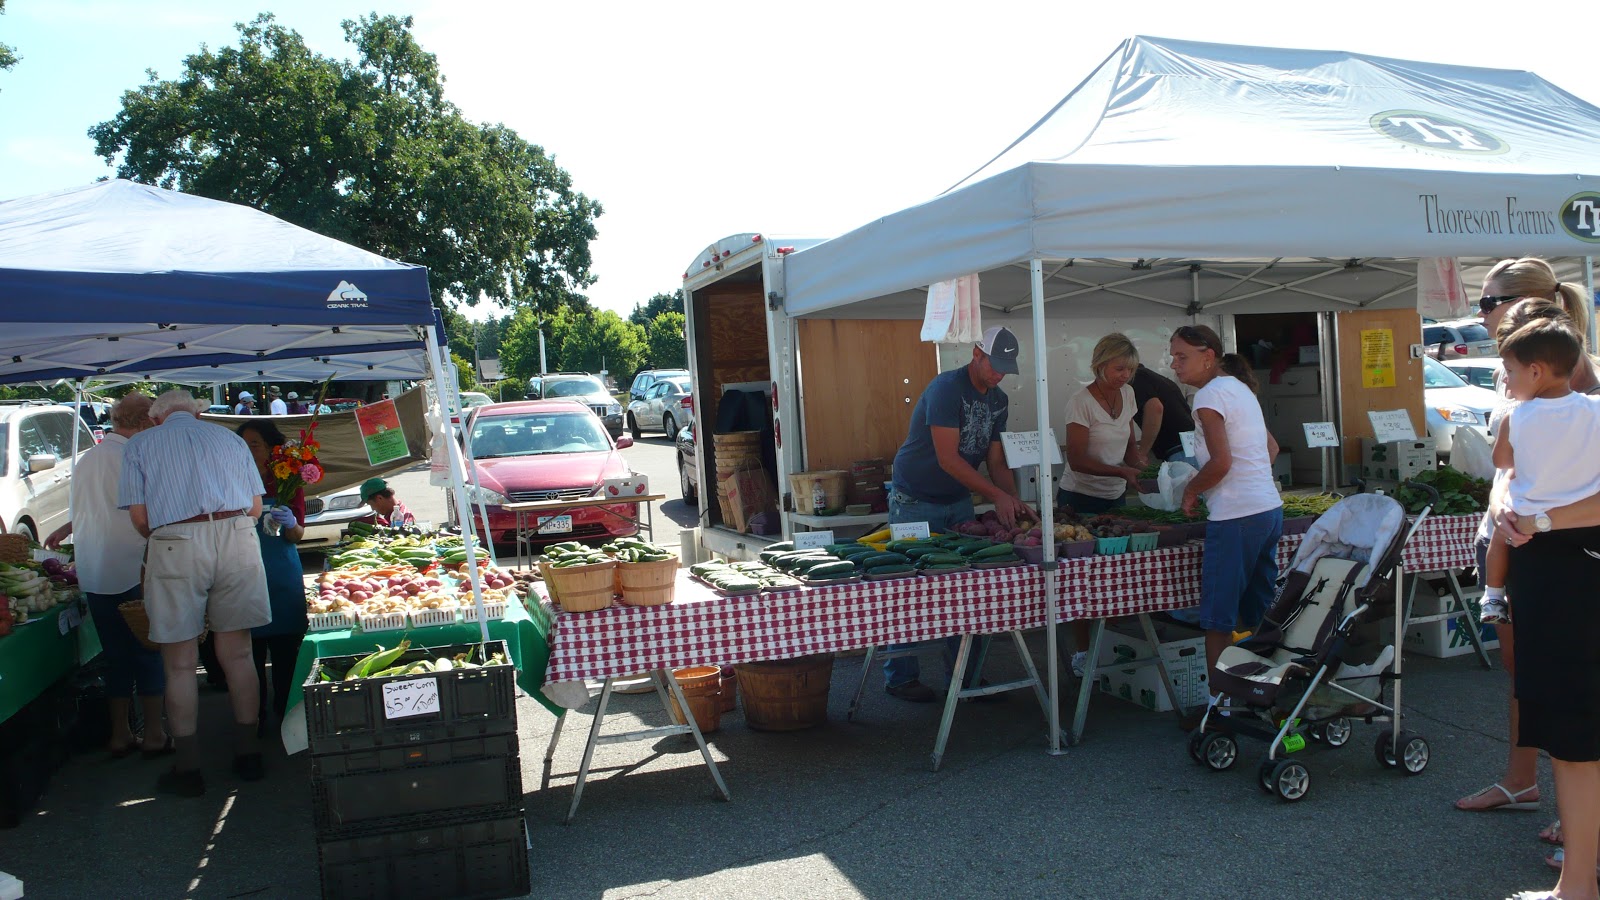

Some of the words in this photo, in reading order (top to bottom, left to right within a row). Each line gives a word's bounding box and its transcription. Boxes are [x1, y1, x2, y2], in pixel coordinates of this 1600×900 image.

[1419, 194, 1503, 235] Thoreson
[1506, 196, 1556, 236] Farms
[385, 682, 415, 694] Sweet
[416, 681, 436, 690] Corn
